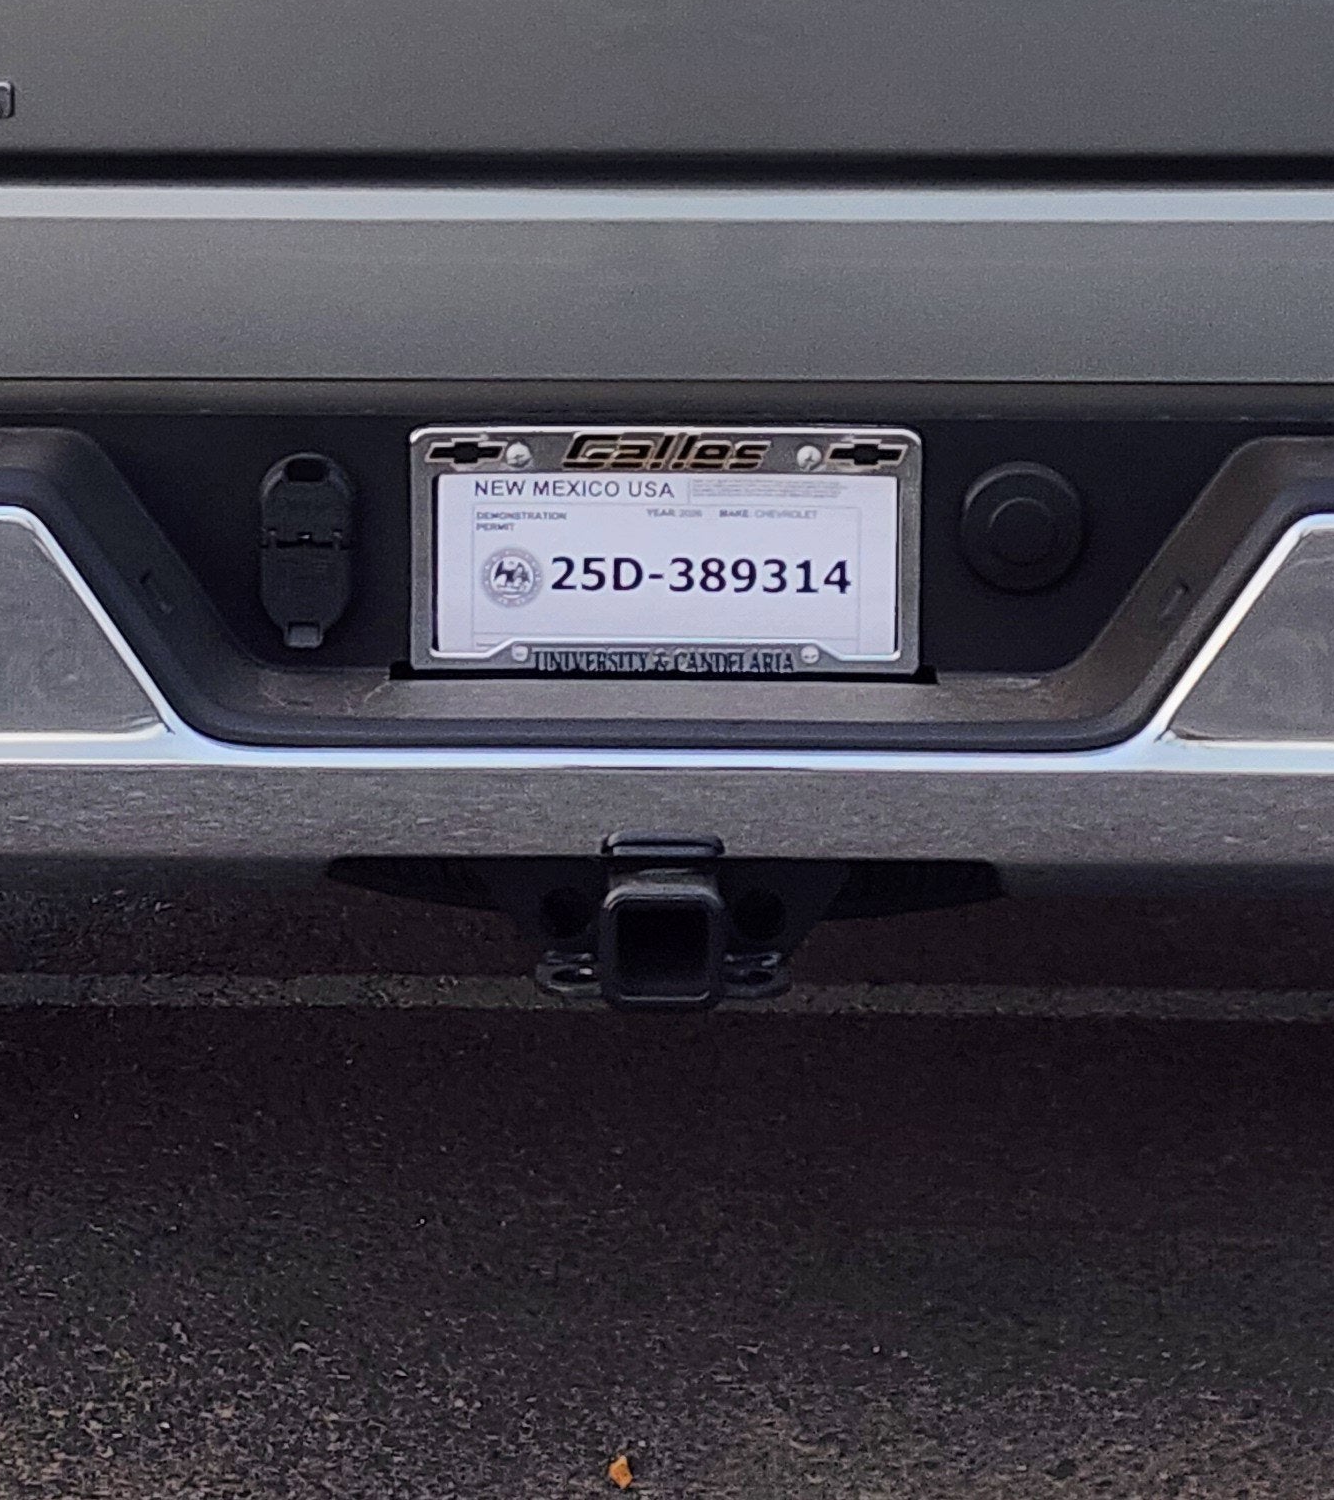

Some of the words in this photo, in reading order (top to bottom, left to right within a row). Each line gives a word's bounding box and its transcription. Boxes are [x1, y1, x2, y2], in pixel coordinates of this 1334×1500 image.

[562, 432, 772, 470] Galles
[474, 480, 525, 497] NEW
[532, 480, 620, 498] MEXICO
[628, 481, 675, 499] USA
[476, 511, 567, 521] DEMONSTRATION
[646, 508, 675, 518] YEAR
[719, 509, 749, 519] MAKE
[754, 509, 818, 520] CHEVROLET
[476, 522, 514, 532] PERMIT
[551, 556, 852, 594] 25D-389314
[534, 650, 649, 672] UNIVERSITY
[653, 650, 668, 672] &
[673, 650, 795, 673] CANDELARIA
